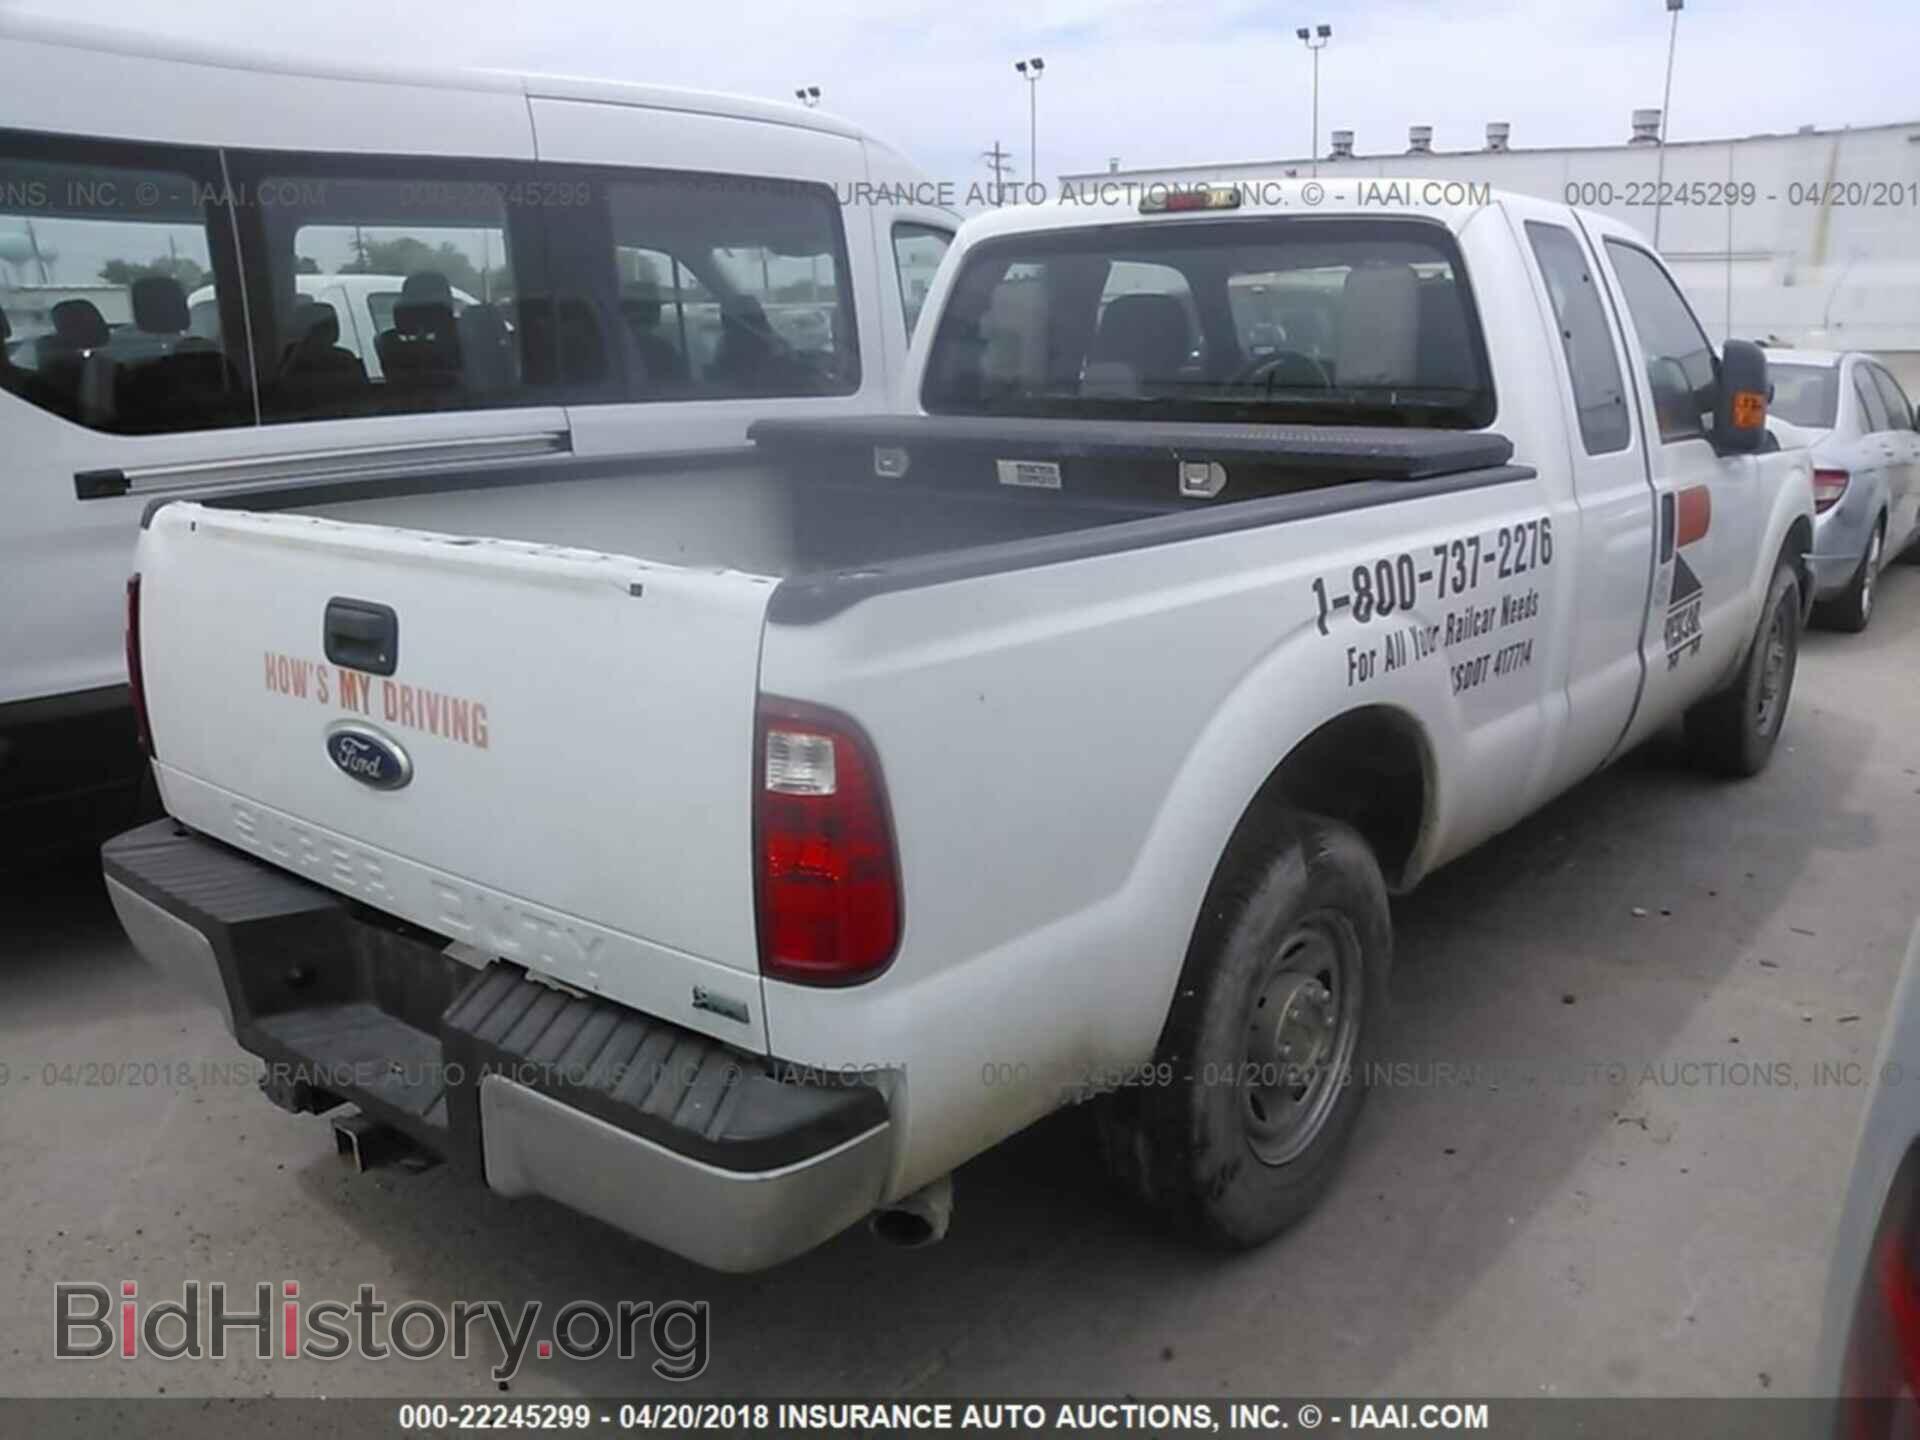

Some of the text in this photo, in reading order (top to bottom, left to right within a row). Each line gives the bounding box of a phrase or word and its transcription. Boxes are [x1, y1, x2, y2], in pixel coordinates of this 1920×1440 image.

[1312, 517, 1552, 636] 1-800-737-2276
[1347, 646, 1376, 687] For
[1384, 629, 1406, 672] All
[1444, 605, 1496, 647] Railcar
[1500, 589, 1539, 628] Needs
[264, 652, 489, 749] HOW'S MY DRIVING
[337, 737, 382, 778] Ford
[228, 799, 396, 904] SUPER
